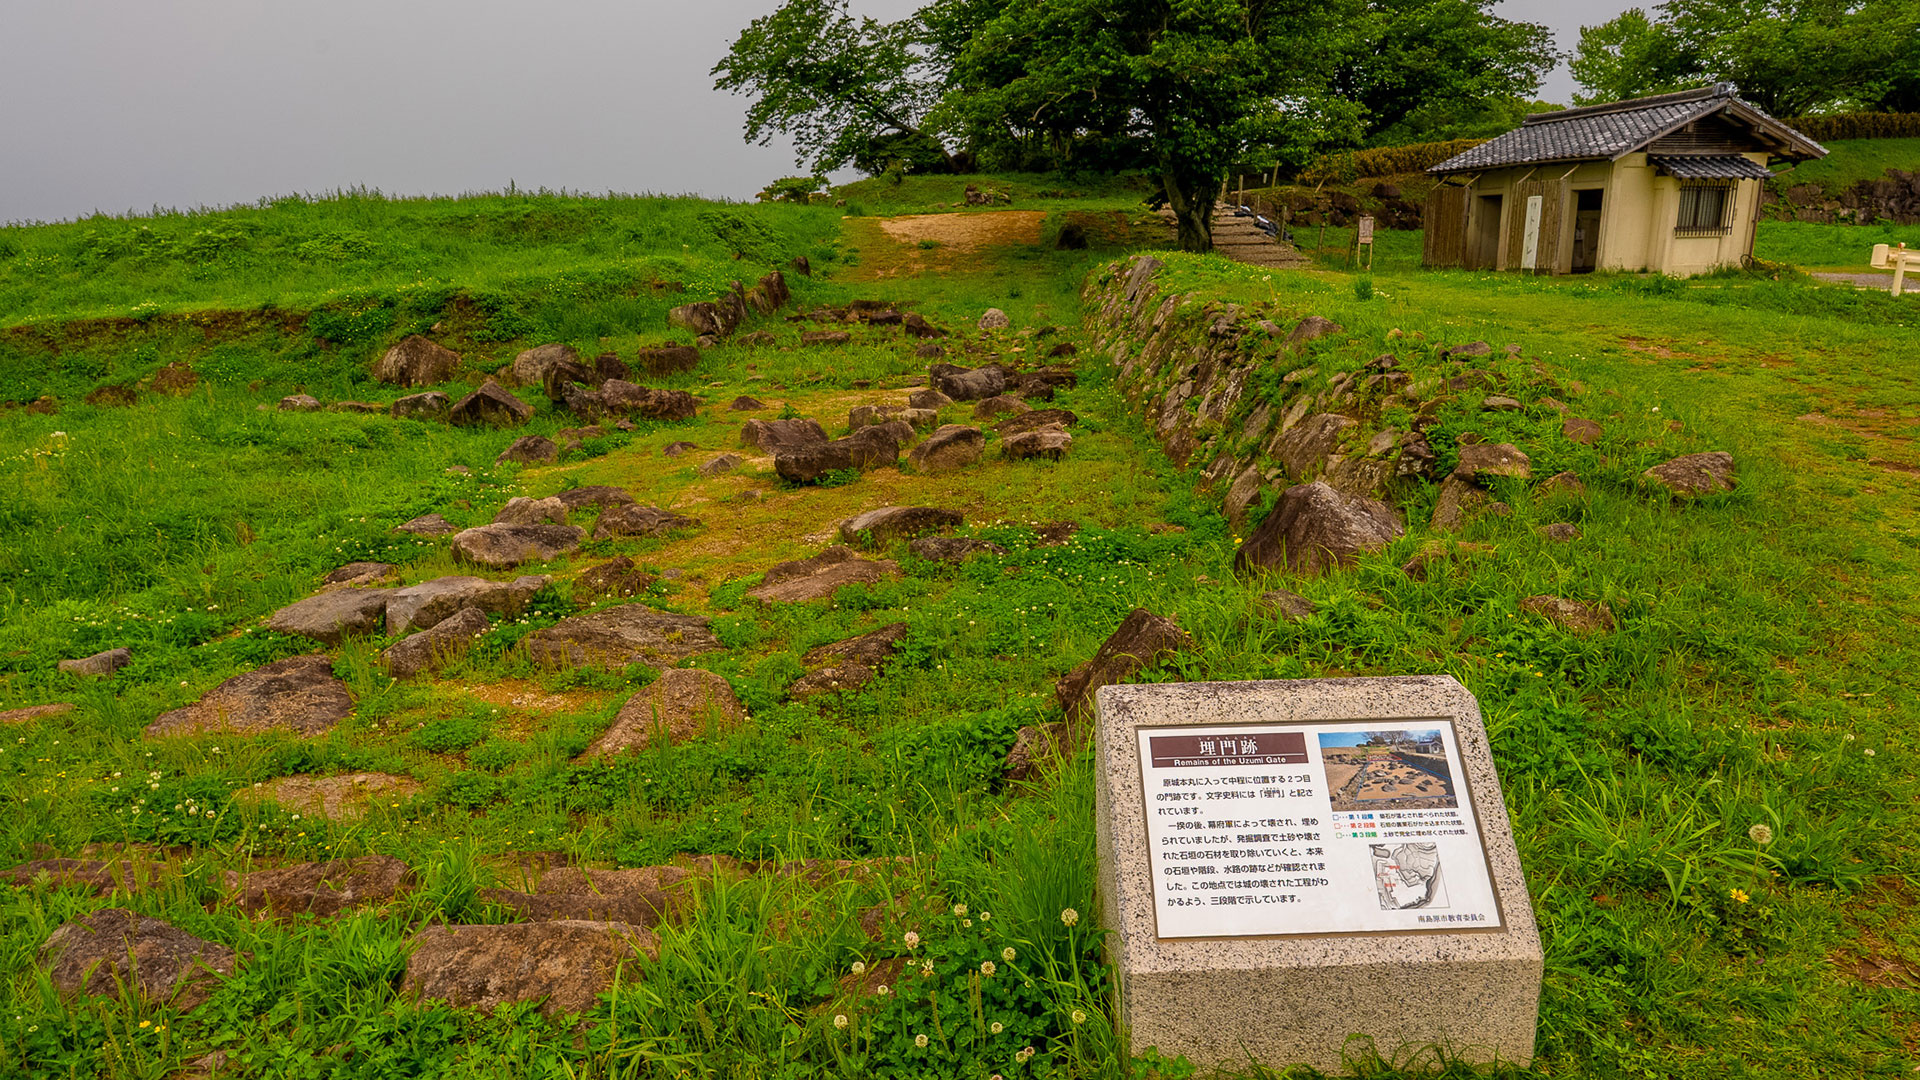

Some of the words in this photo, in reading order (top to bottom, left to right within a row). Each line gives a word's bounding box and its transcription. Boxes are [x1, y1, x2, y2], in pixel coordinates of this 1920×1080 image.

[1199, 739, 1258, 756] 埋門跡
[1174, 758, 1209, 766] Remains
[1212, 758, 1221, 766] of
[1239, 757, 1264, 765] Uzumi
[1266, 756, 1286, 764] Gate
[1158, 806, 1204, 816] れています。
